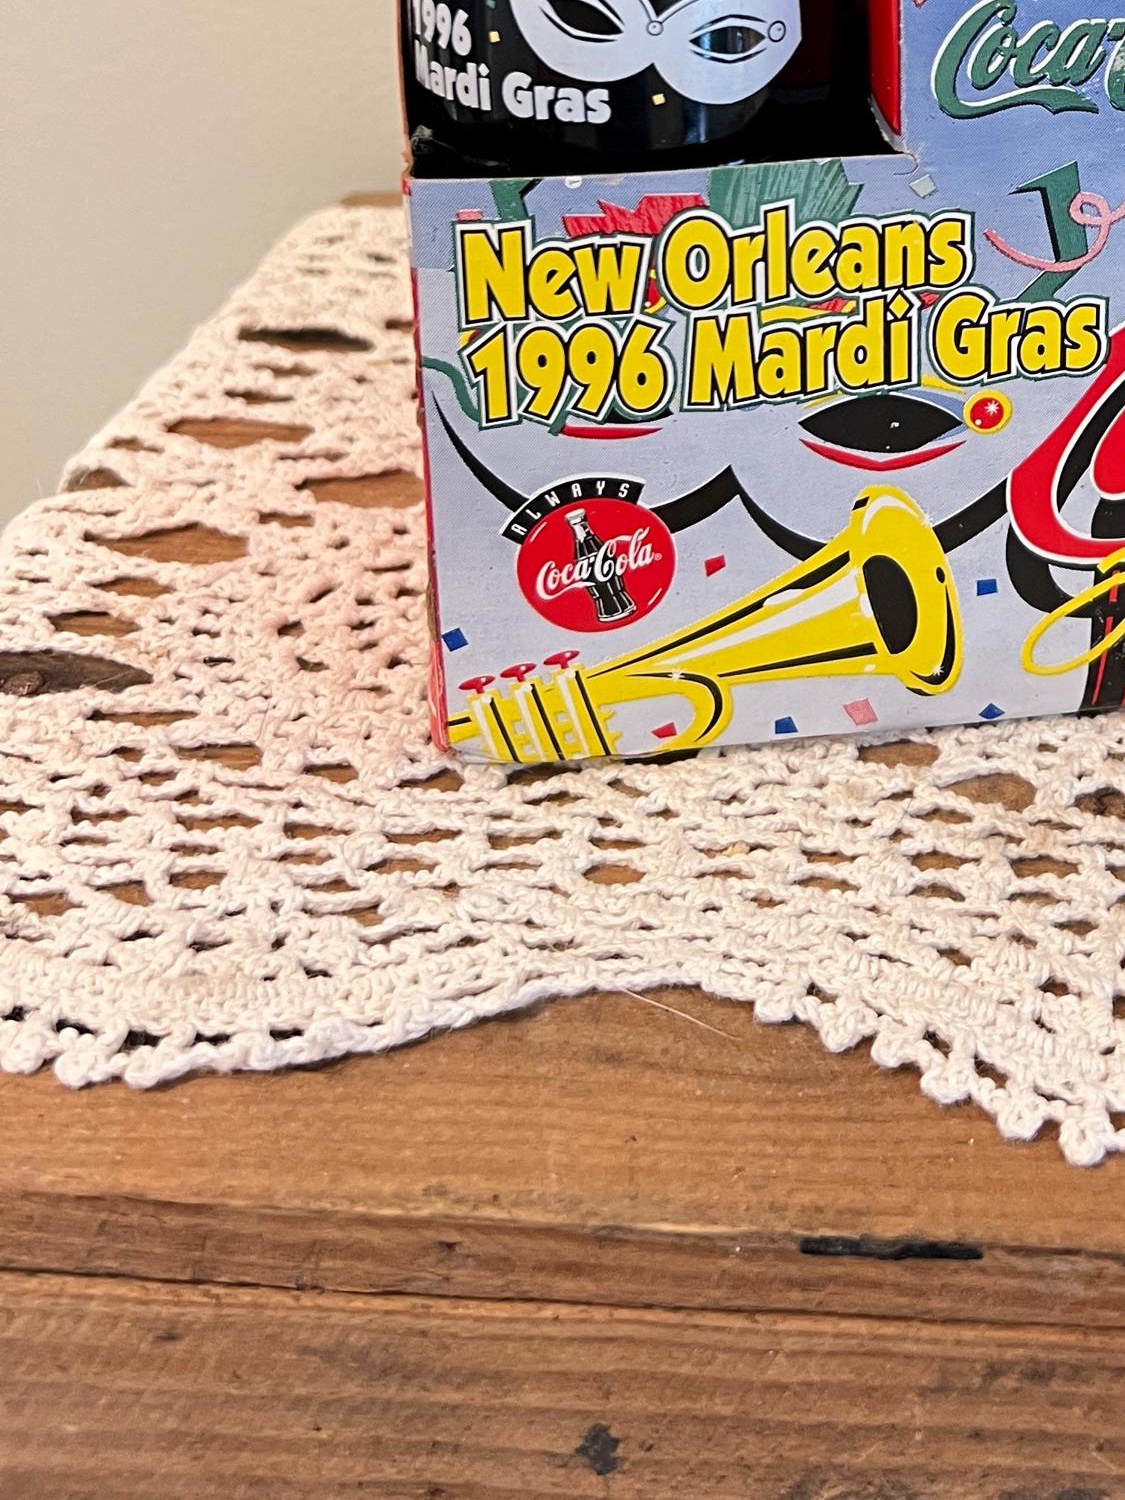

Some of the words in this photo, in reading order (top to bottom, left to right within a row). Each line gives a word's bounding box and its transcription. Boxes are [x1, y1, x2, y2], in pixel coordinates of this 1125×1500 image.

[414, 39, 492, 111] Mardi
[502, 71, 612, 124] Gras
[459, 224, 649, 326] New
[661, 201, 968, 311] Orleans
[464, 318, 668, 424] 1996
[688, 292, 914, 409] Mardi
[932, 294, 1104, 384] Gras
[510, 480, 630, 536] ALWAYS
[535, 526, 656, 601] Coca-Cola
